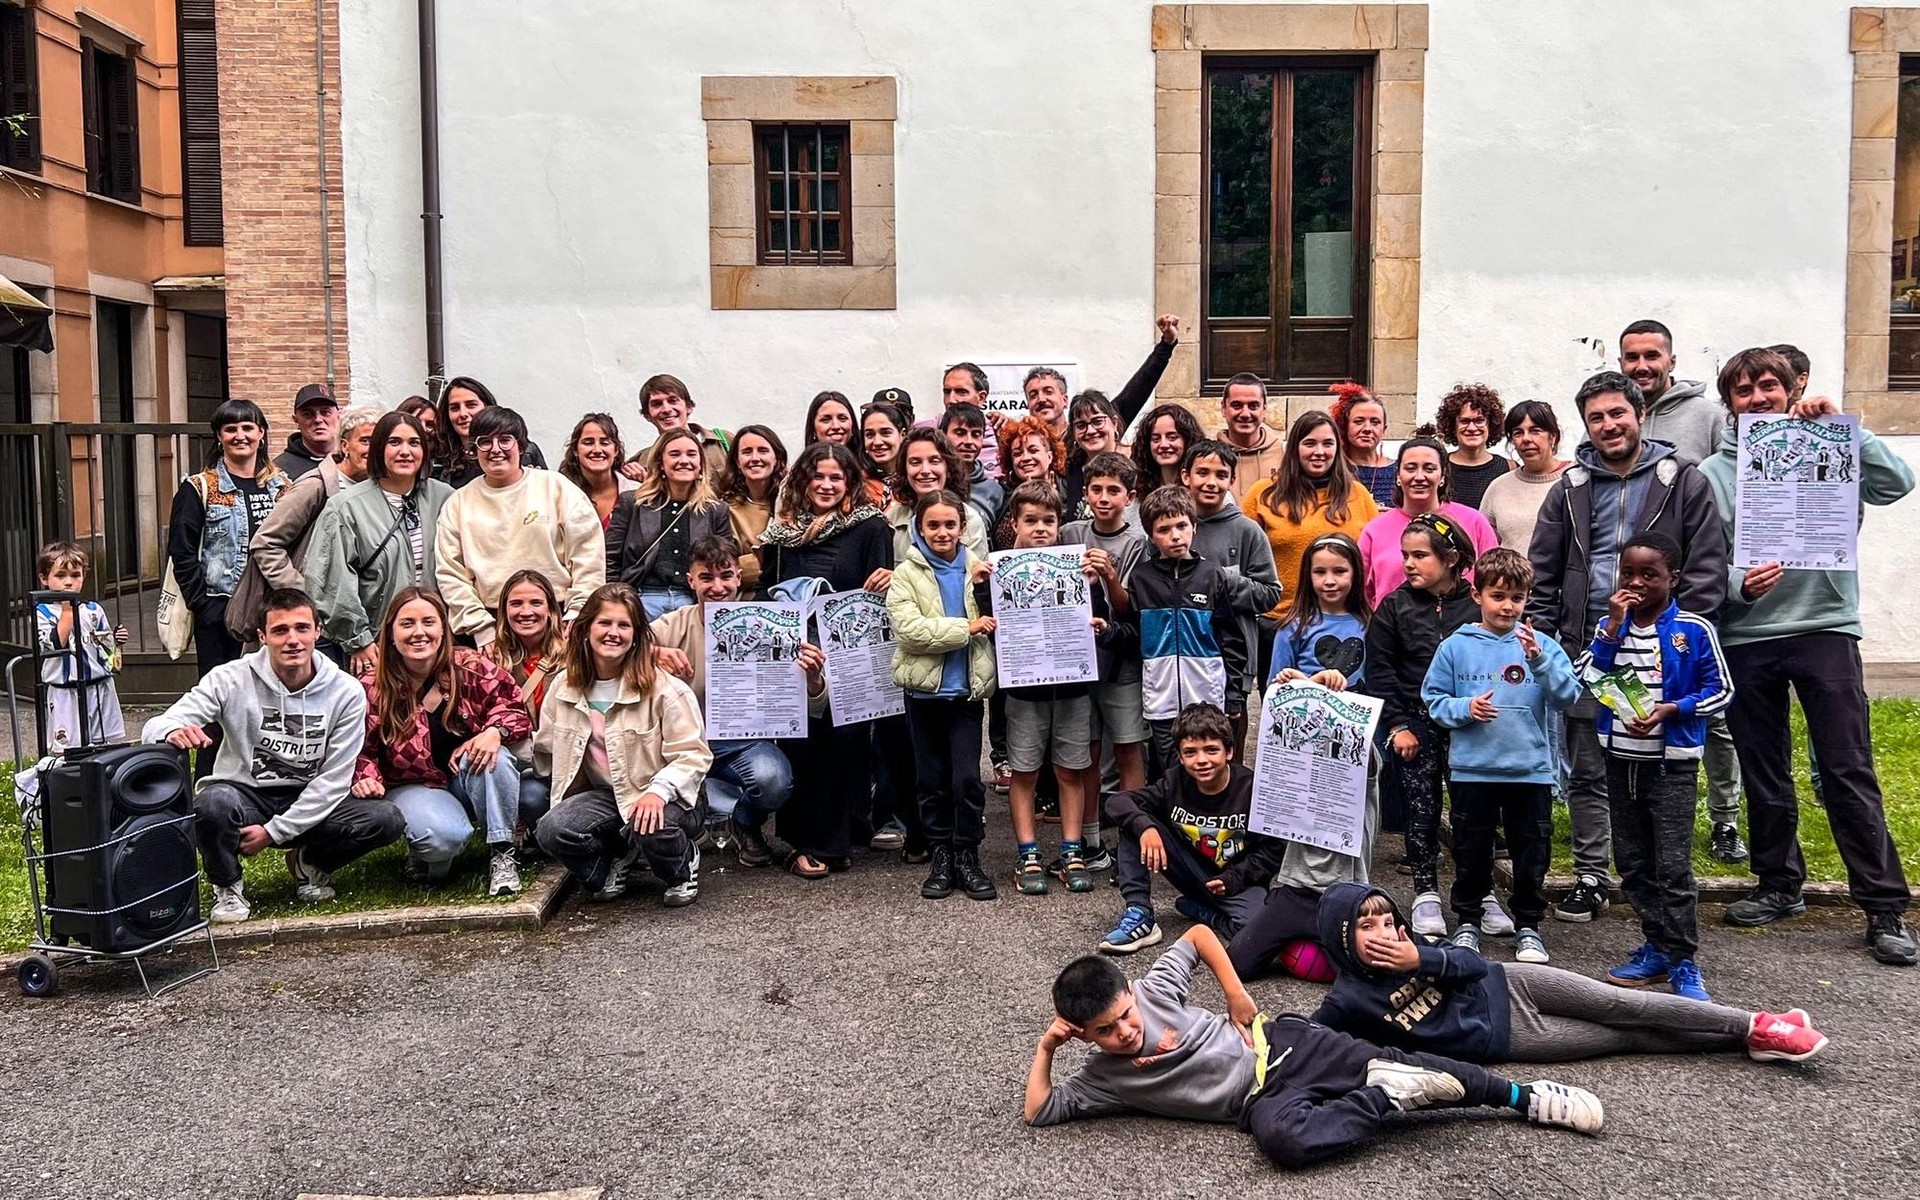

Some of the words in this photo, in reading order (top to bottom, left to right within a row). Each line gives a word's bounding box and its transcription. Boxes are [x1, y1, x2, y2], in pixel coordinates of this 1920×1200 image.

[1806, 422, 1848, 441] JAIXAK
[1828, 422, 1851, 432] 2025
[1060, 553, 1080, 561] 2025
[1348, 702, 1373, 715] 2025
[260, 737, 322, 755] DISTRICT
[1170, 806, 1247, 829] IMPOSTOR
[1394, 986, 1443, 1032] PWR
